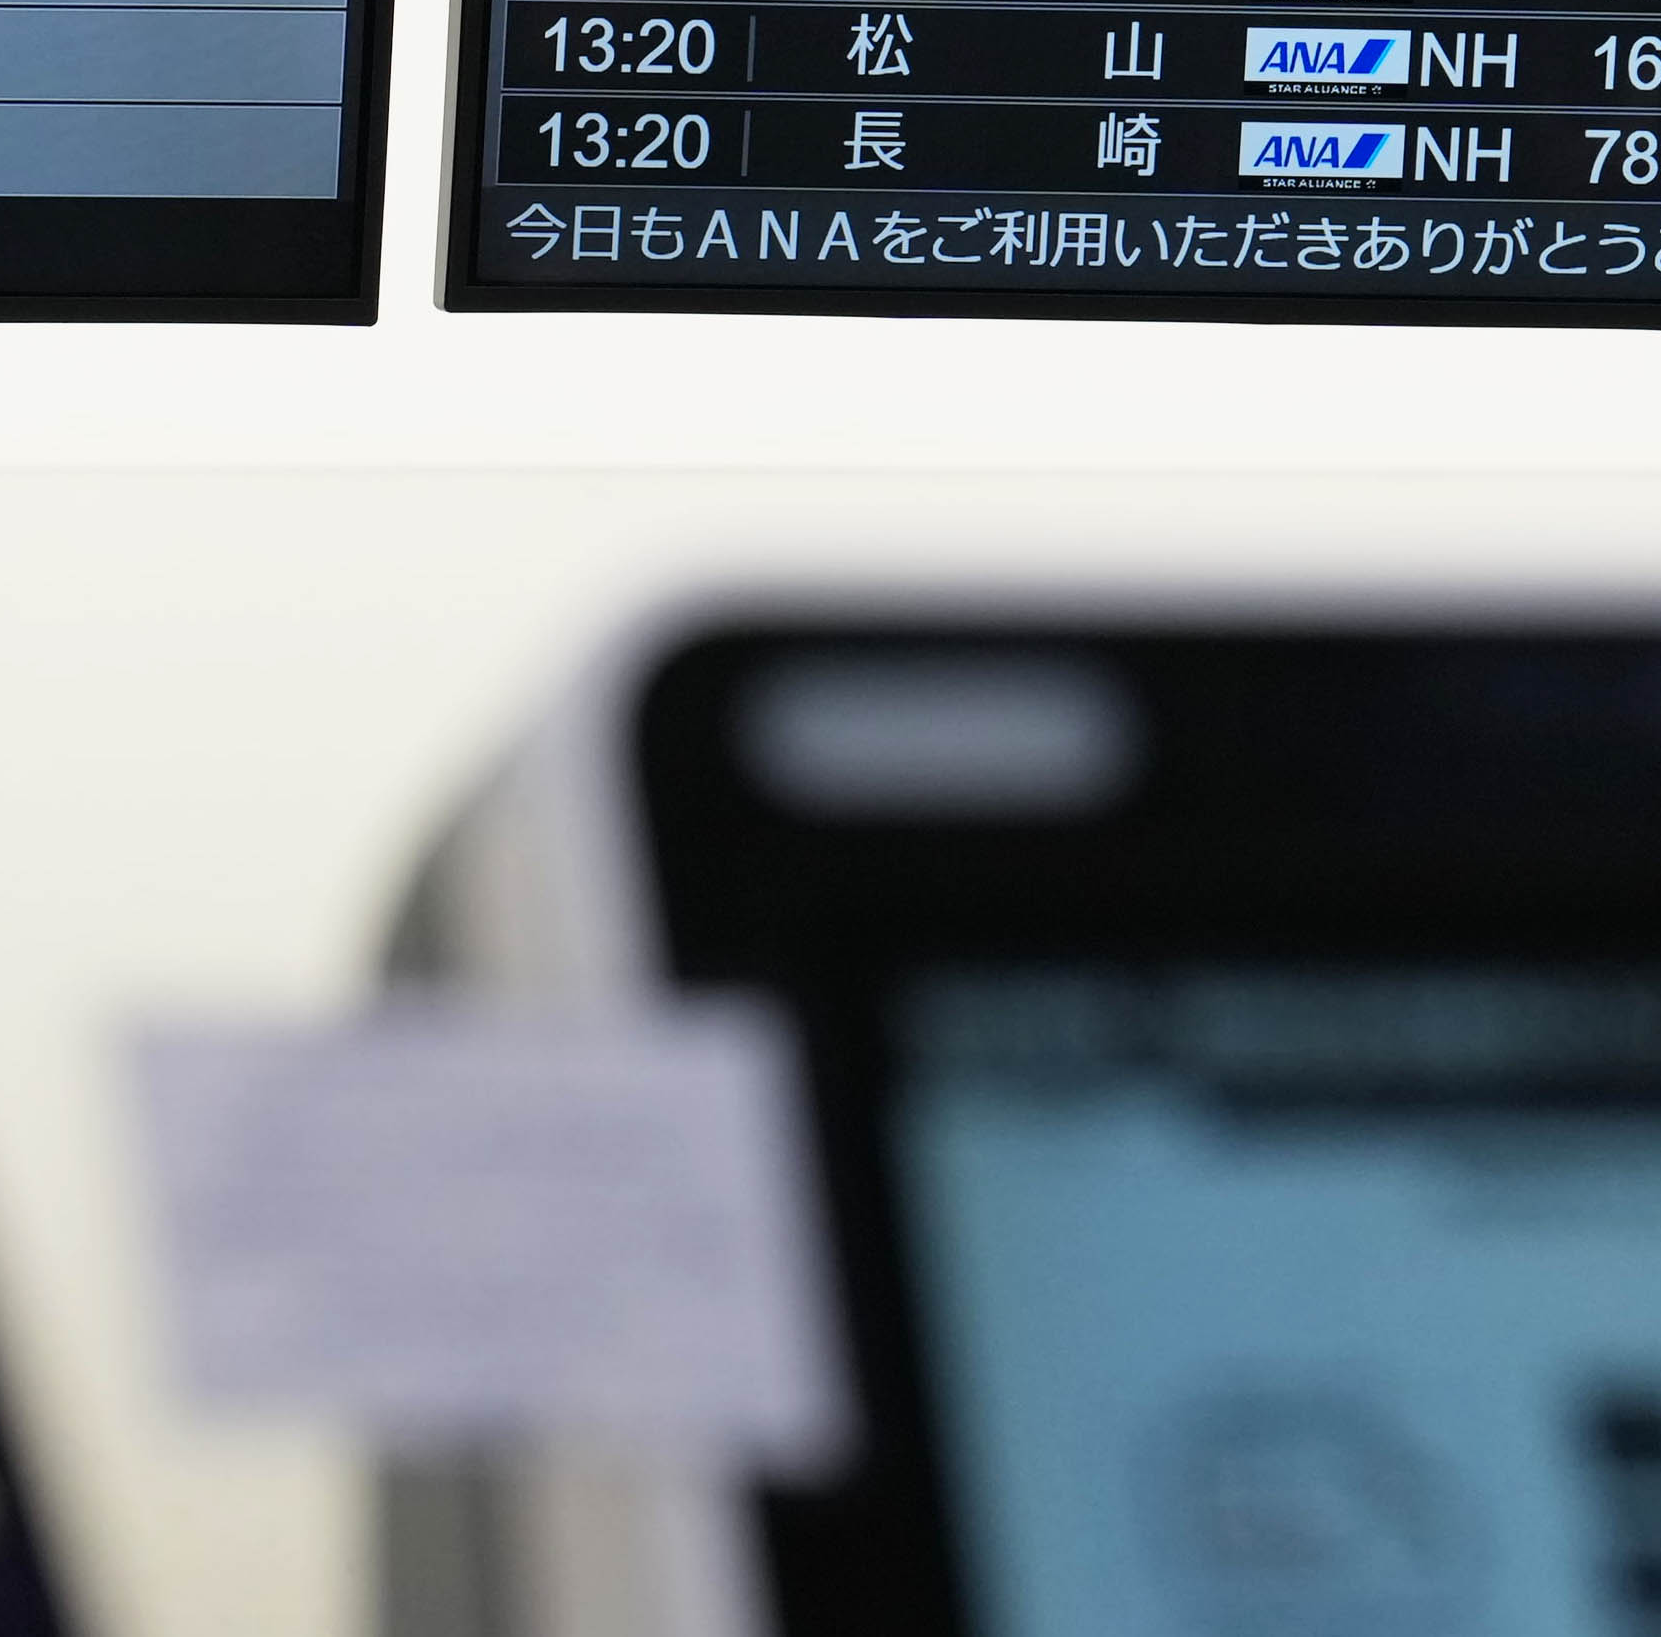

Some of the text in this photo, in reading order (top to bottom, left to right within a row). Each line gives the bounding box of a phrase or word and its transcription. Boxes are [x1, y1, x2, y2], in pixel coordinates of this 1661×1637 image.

[544, 16, 715, 75] 13:20
[1259, 42, 1346, 74] ANA
[1420, 31, 1518, 89] NH
[539, 111, 710, 169] 13:20
[1253, 135, 1339, 169] ANA
[1414, 126, 1512, 183] NH
